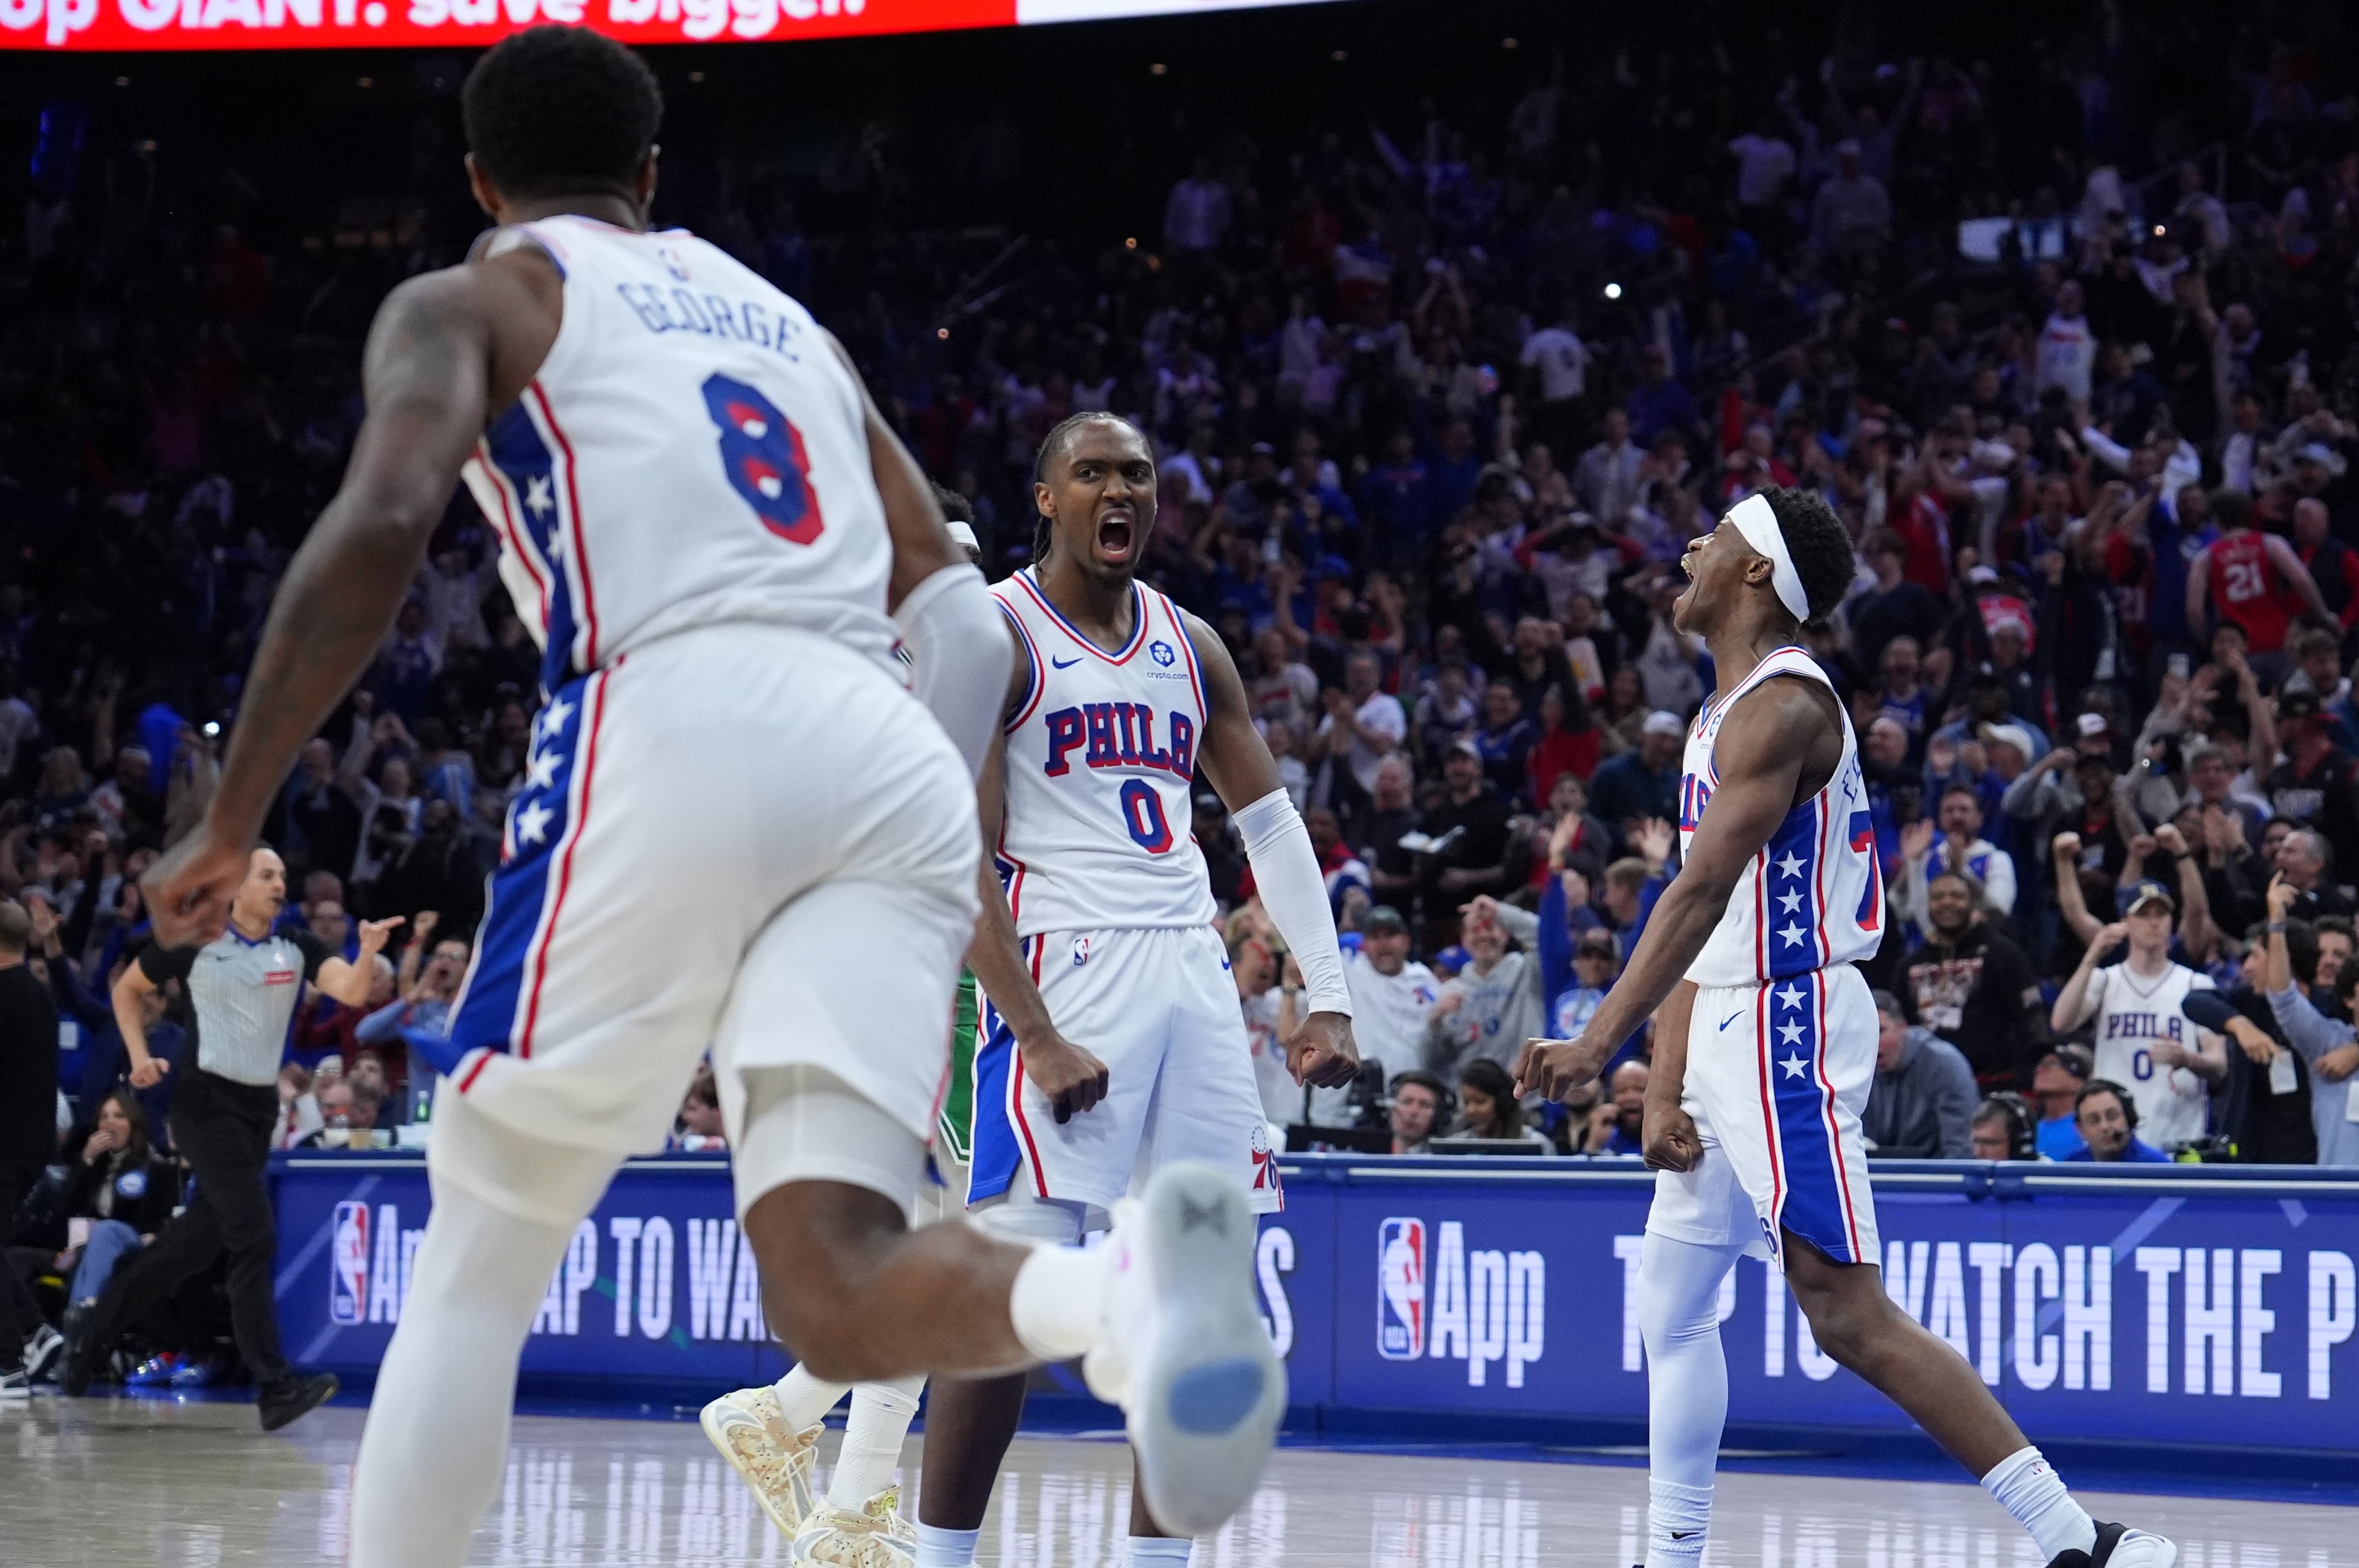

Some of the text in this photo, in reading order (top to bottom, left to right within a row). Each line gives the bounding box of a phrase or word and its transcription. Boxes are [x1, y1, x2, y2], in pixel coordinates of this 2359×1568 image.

[616, 283, 801, 364] GEORGE
[702, 372, 824, 547] 8
[2223, 559, 2266, 603] 21
[1146, 671, 1189, 681] crypto.com
[1044, 702, 1194, 782] PHILA
[1119, 779, 1174, 854] 0
[2107, 1012, 2183, 1043] PHILA
[2133, 1049, 2153, 1081] 0
[611, 1215, 675, 1340] TO
[1430, 1221, 1546, 1388] App
[2135, 1246, 2282, 1398] THE
